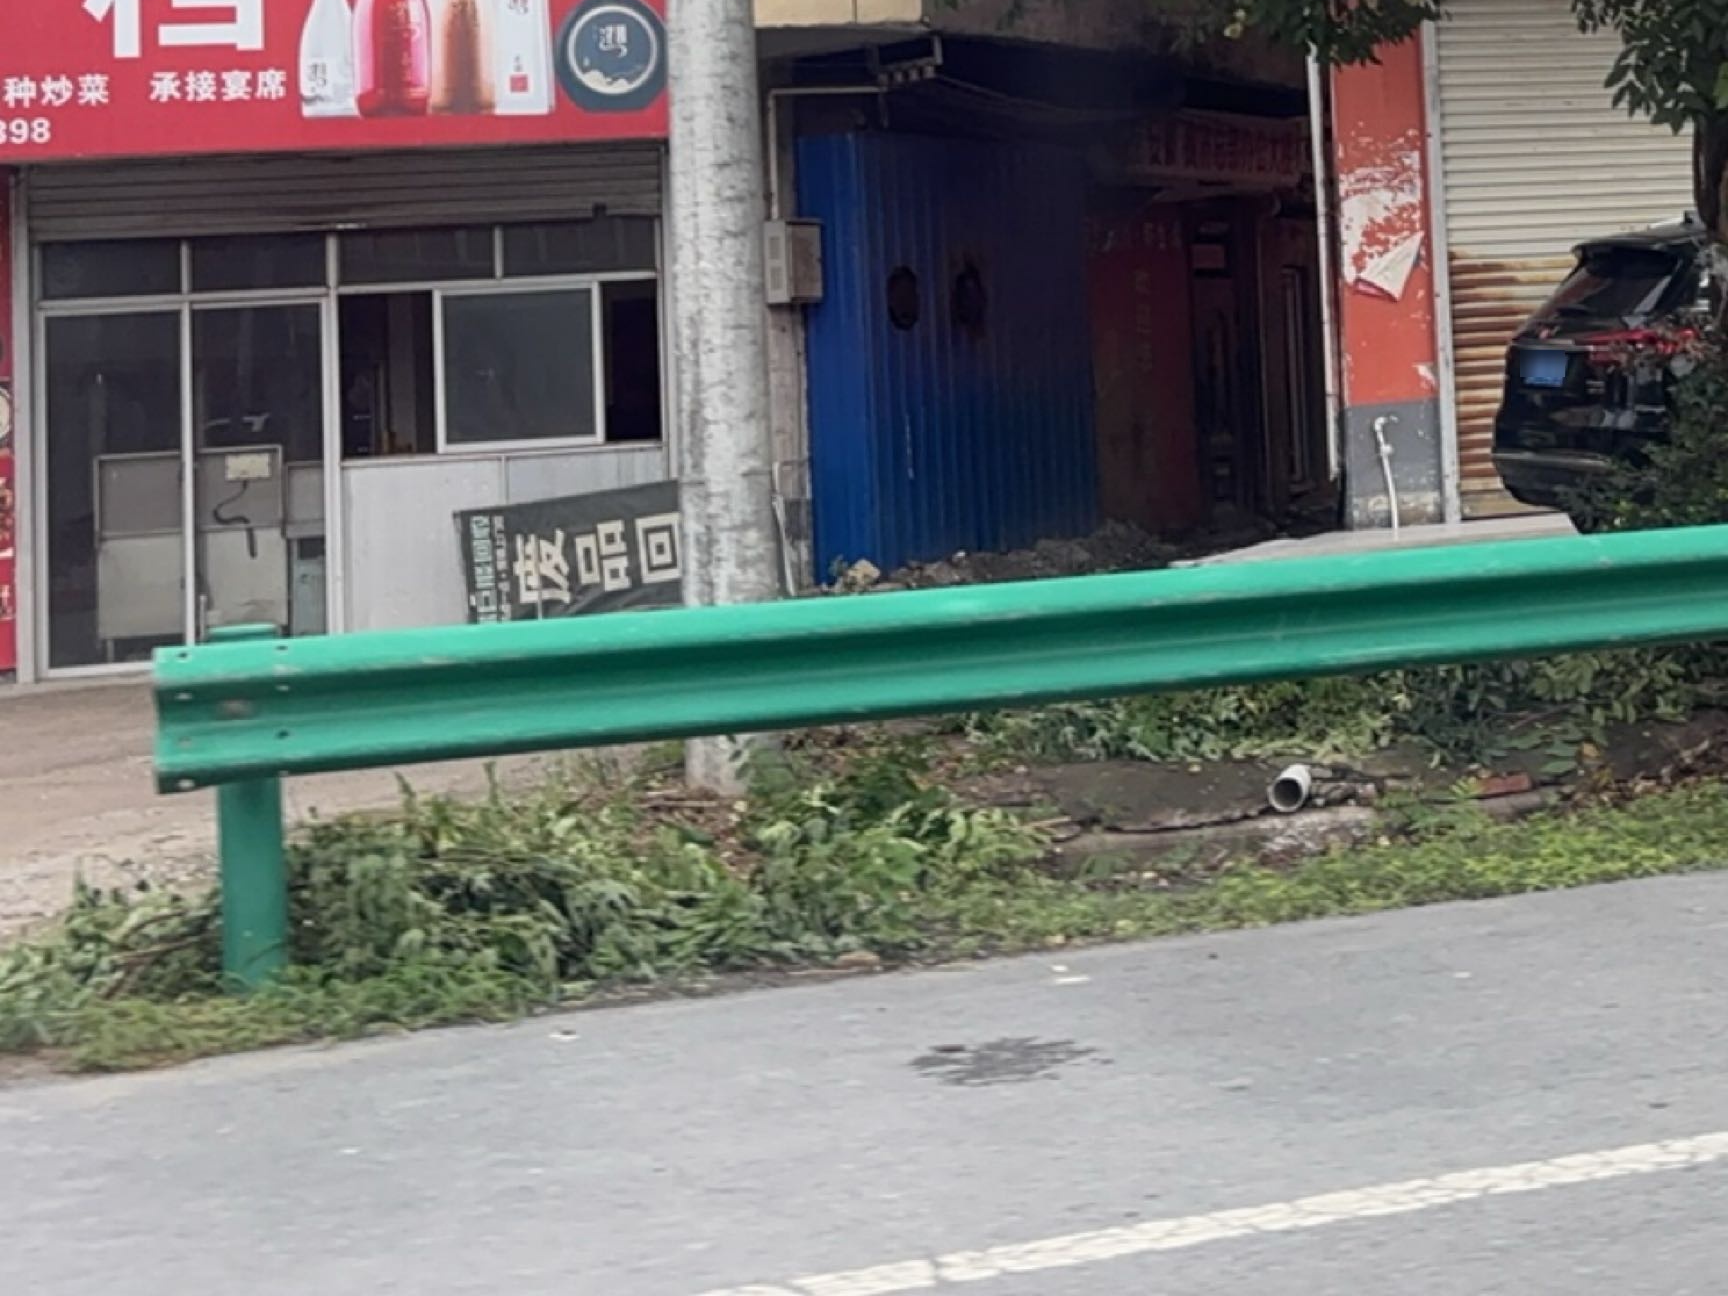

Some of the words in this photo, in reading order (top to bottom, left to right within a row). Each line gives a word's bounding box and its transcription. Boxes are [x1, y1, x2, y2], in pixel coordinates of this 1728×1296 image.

[5, 73, 110, 108] 种炒菜
[150, 69, 288, 102] 承接宴席
